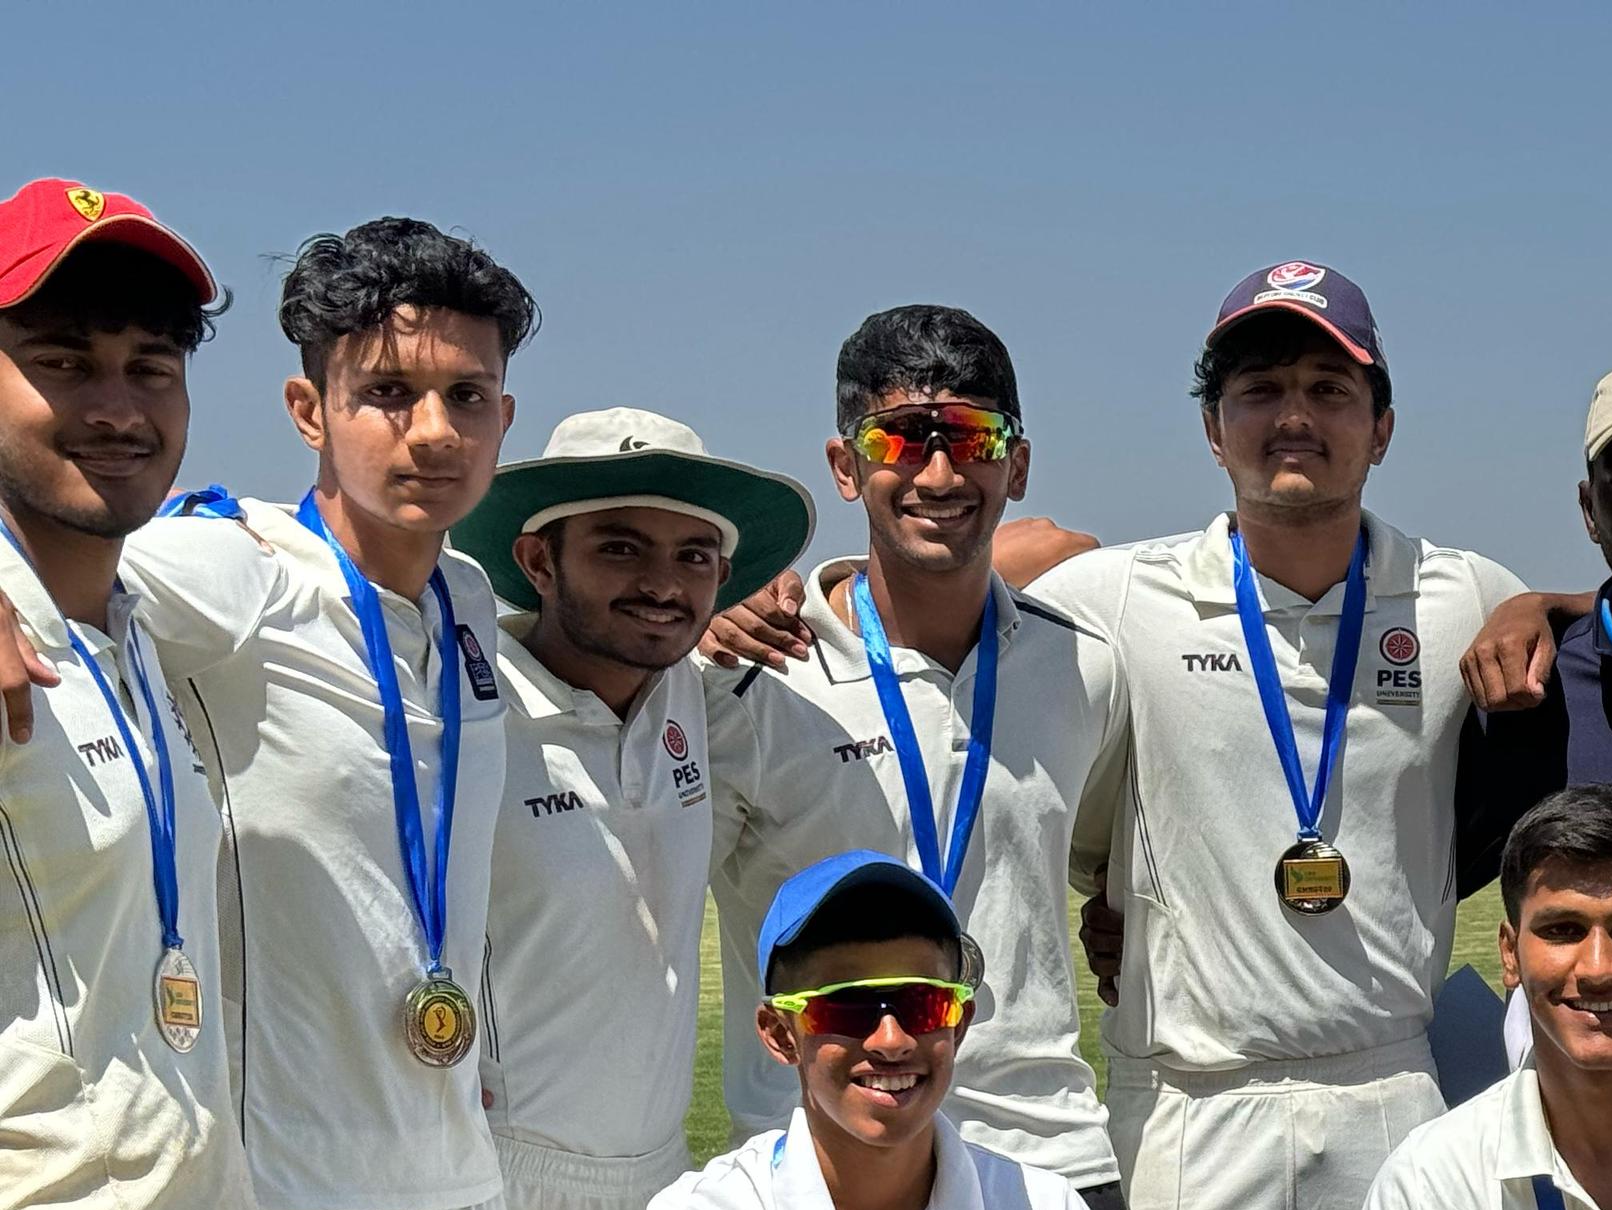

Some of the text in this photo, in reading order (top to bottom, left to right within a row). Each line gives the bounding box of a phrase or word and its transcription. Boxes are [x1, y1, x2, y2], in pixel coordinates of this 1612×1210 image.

[1182, 654, 1242, 672] TYKA
[1377, 670, 1422, 688] PES
[833, 735, 895, 763] TYKA
[672, 761, 701, 789] PES
[524, 790, 584, 818] TYKA
